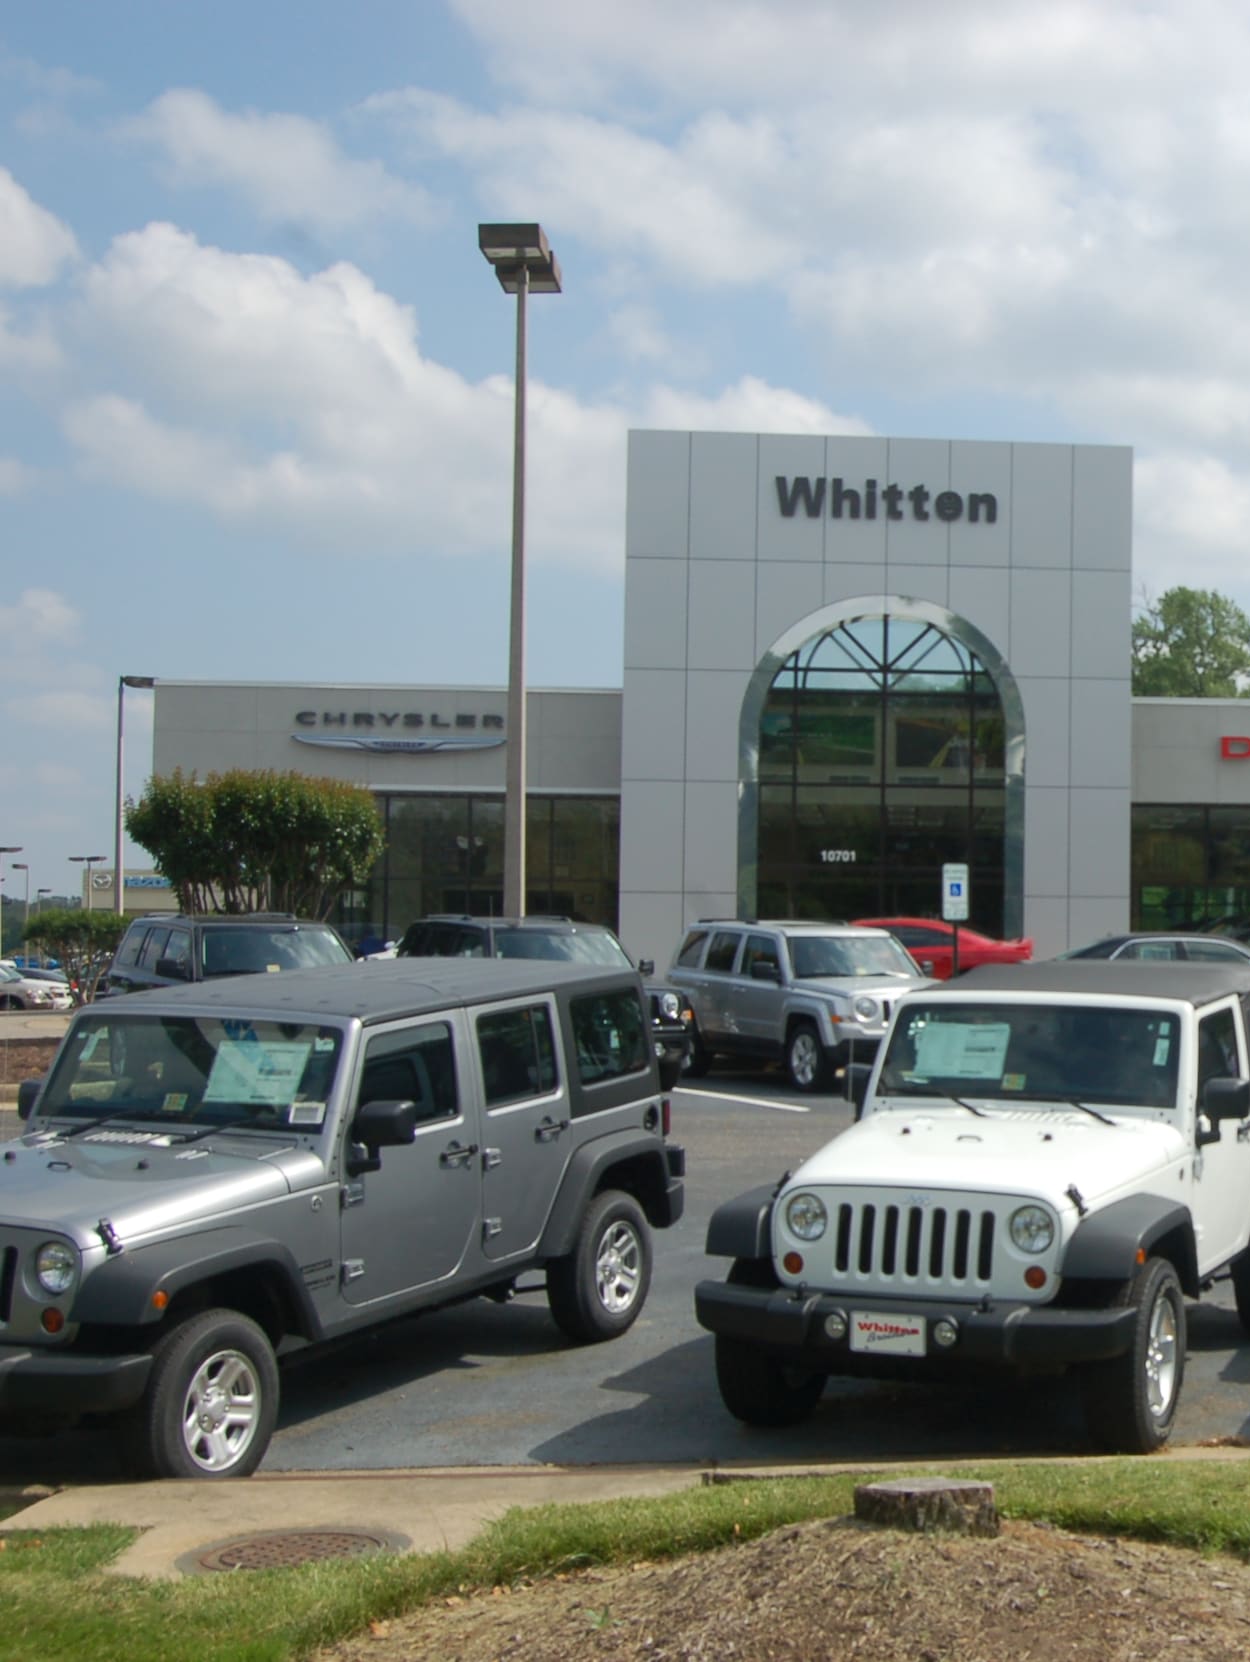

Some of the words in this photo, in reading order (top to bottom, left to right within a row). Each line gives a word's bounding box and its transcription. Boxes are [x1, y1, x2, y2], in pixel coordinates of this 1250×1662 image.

[775, 476, 998, 524] Whitten
[296, 712, 505, 728] CHRYSLER
[821, 851, 856, 862] 10701
